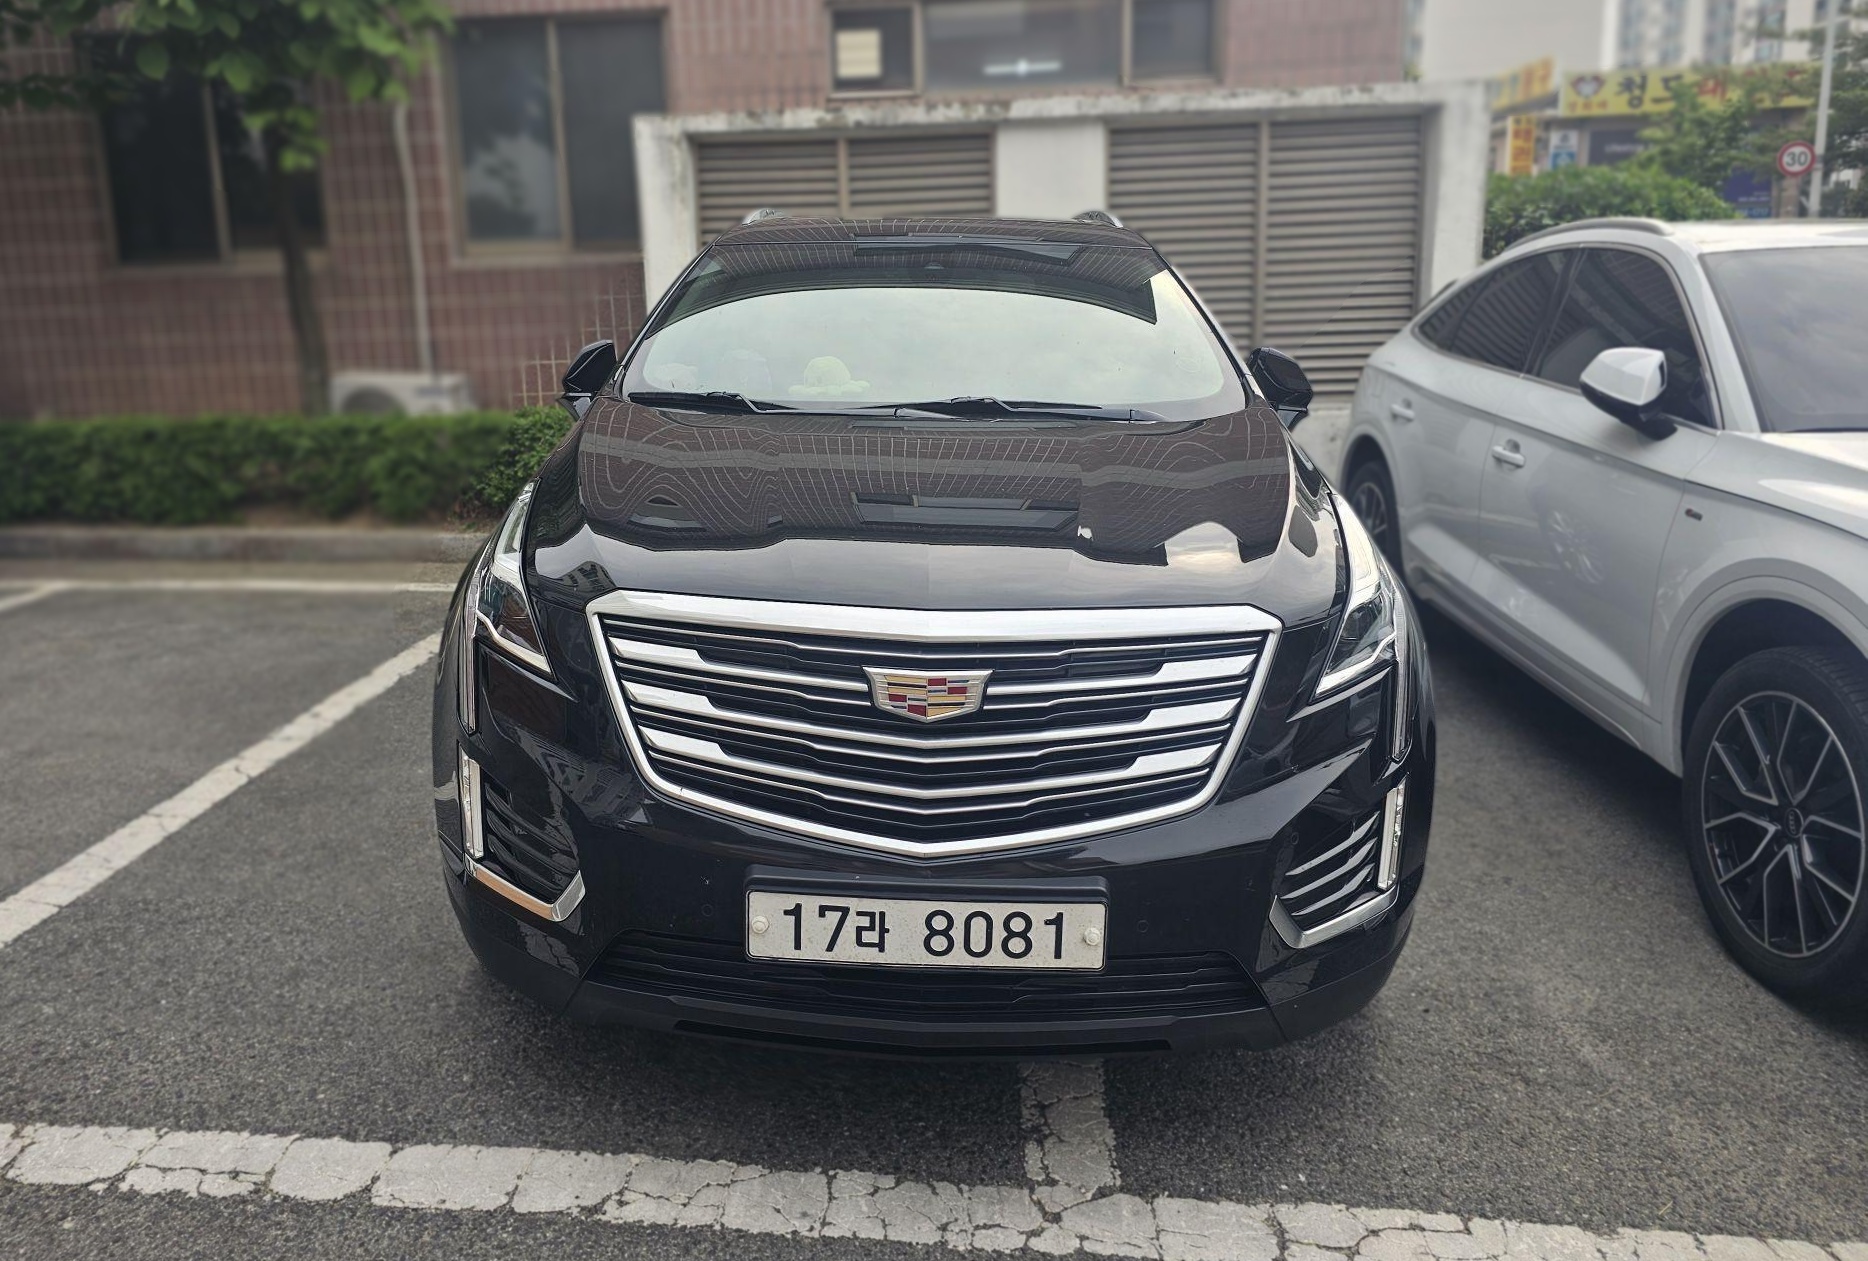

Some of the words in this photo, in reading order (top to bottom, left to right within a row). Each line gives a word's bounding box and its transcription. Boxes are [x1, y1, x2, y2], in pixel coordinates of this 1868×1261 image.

[1785, 151, 1809, 167] 30
[782, 902, 890, 953] 17라
[923, 909, 1065, 960] 8081
